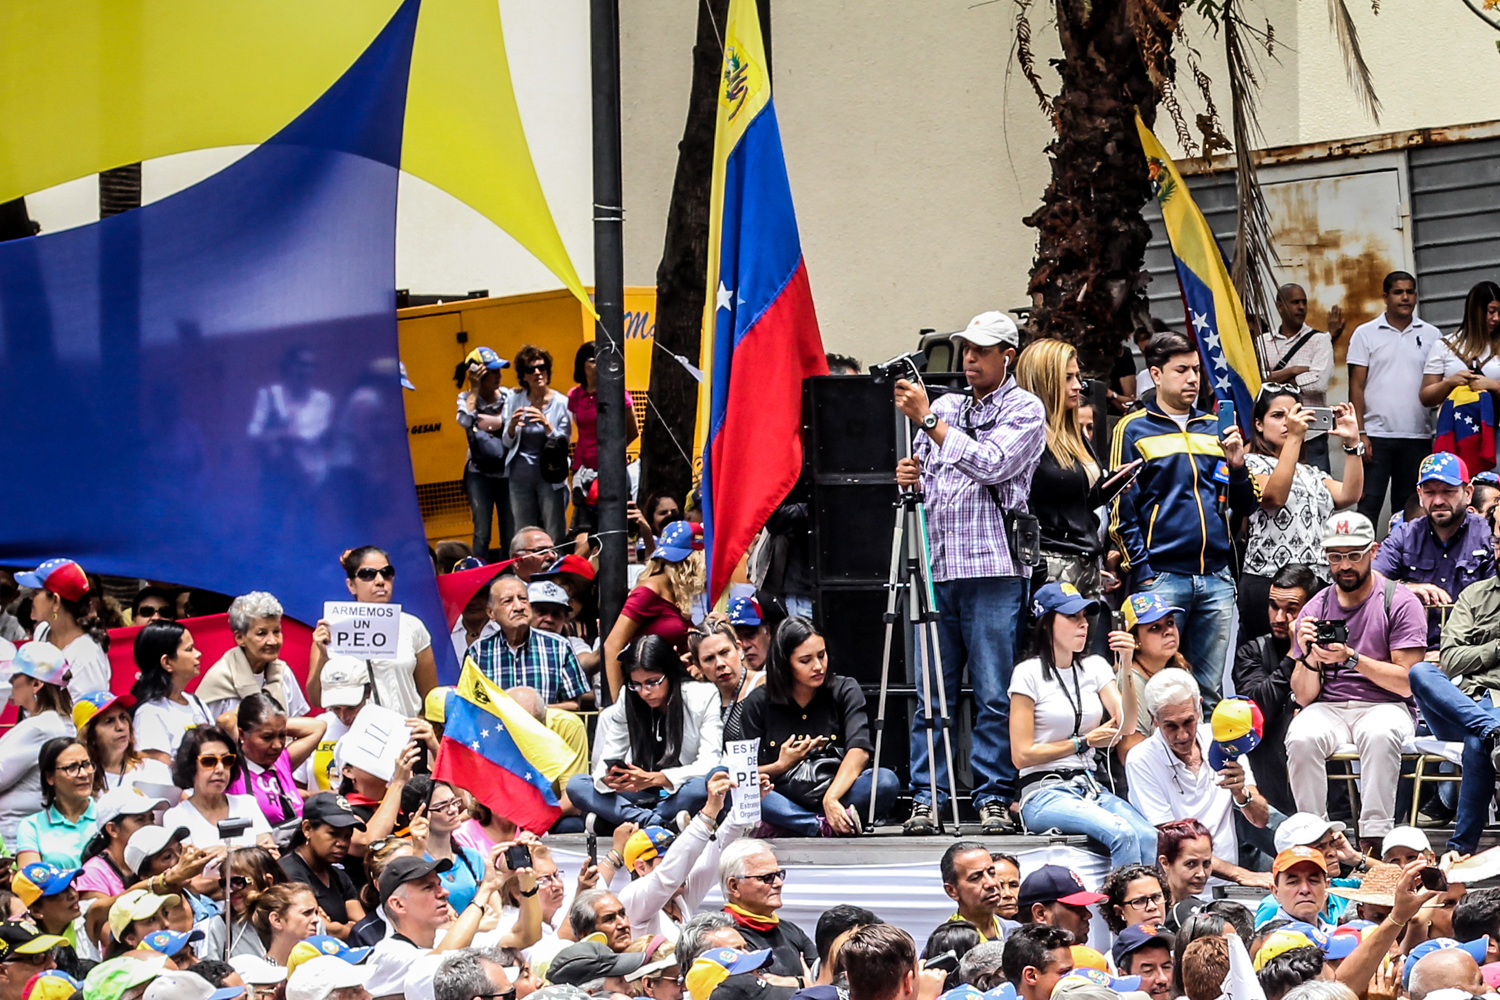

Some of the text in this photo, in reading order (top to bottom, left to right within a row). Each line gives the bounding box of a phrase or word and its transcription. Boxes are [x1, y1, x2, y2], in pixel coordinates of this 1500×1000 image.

[411, 422, 442, 434] GESAN
[1335, 520, 1349, 534] M
[332, 606, 393, 617] ARMEMOS
[353, 620, 370, 629] UN
[337, 632, 387, 647] P.E.O
[733, 744, 747, 754] ES
[747, 757, 757, 766] DE
